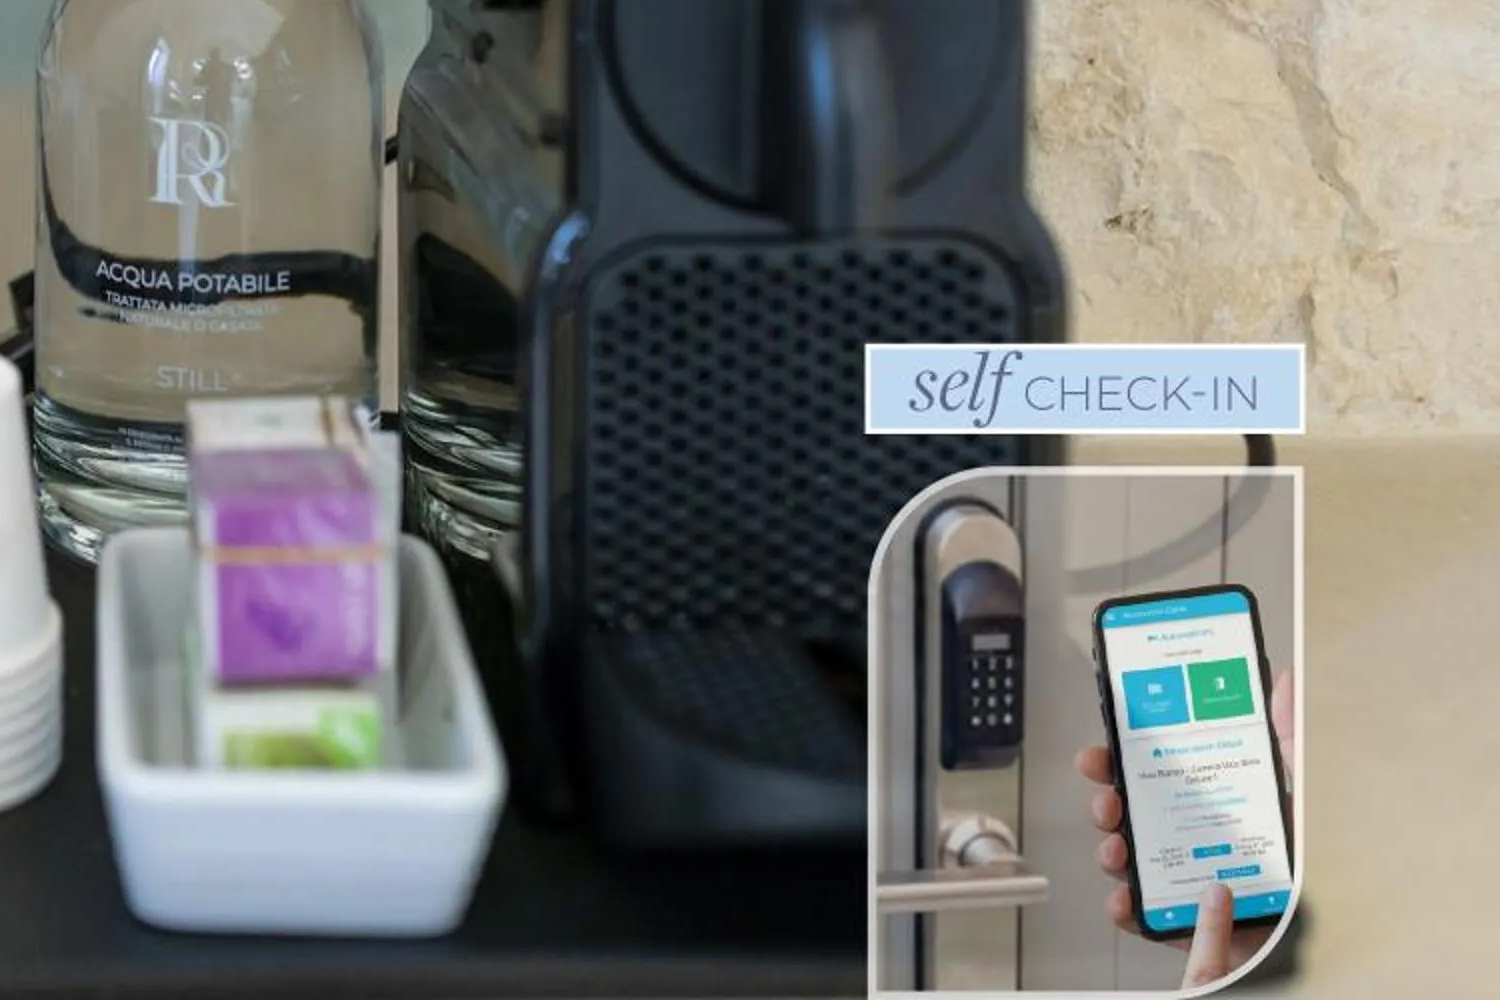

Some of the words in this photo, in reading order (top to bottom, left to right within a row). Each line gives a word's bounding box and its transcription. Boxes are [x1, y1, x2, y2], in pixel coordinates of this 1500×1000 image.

[95, 259, 174, 292] ACQUA
[178, 270, 291, 295] POTABILE
[104, 289, 170, 314] TRATTATA
[156, 365, 229, 392] STILL
